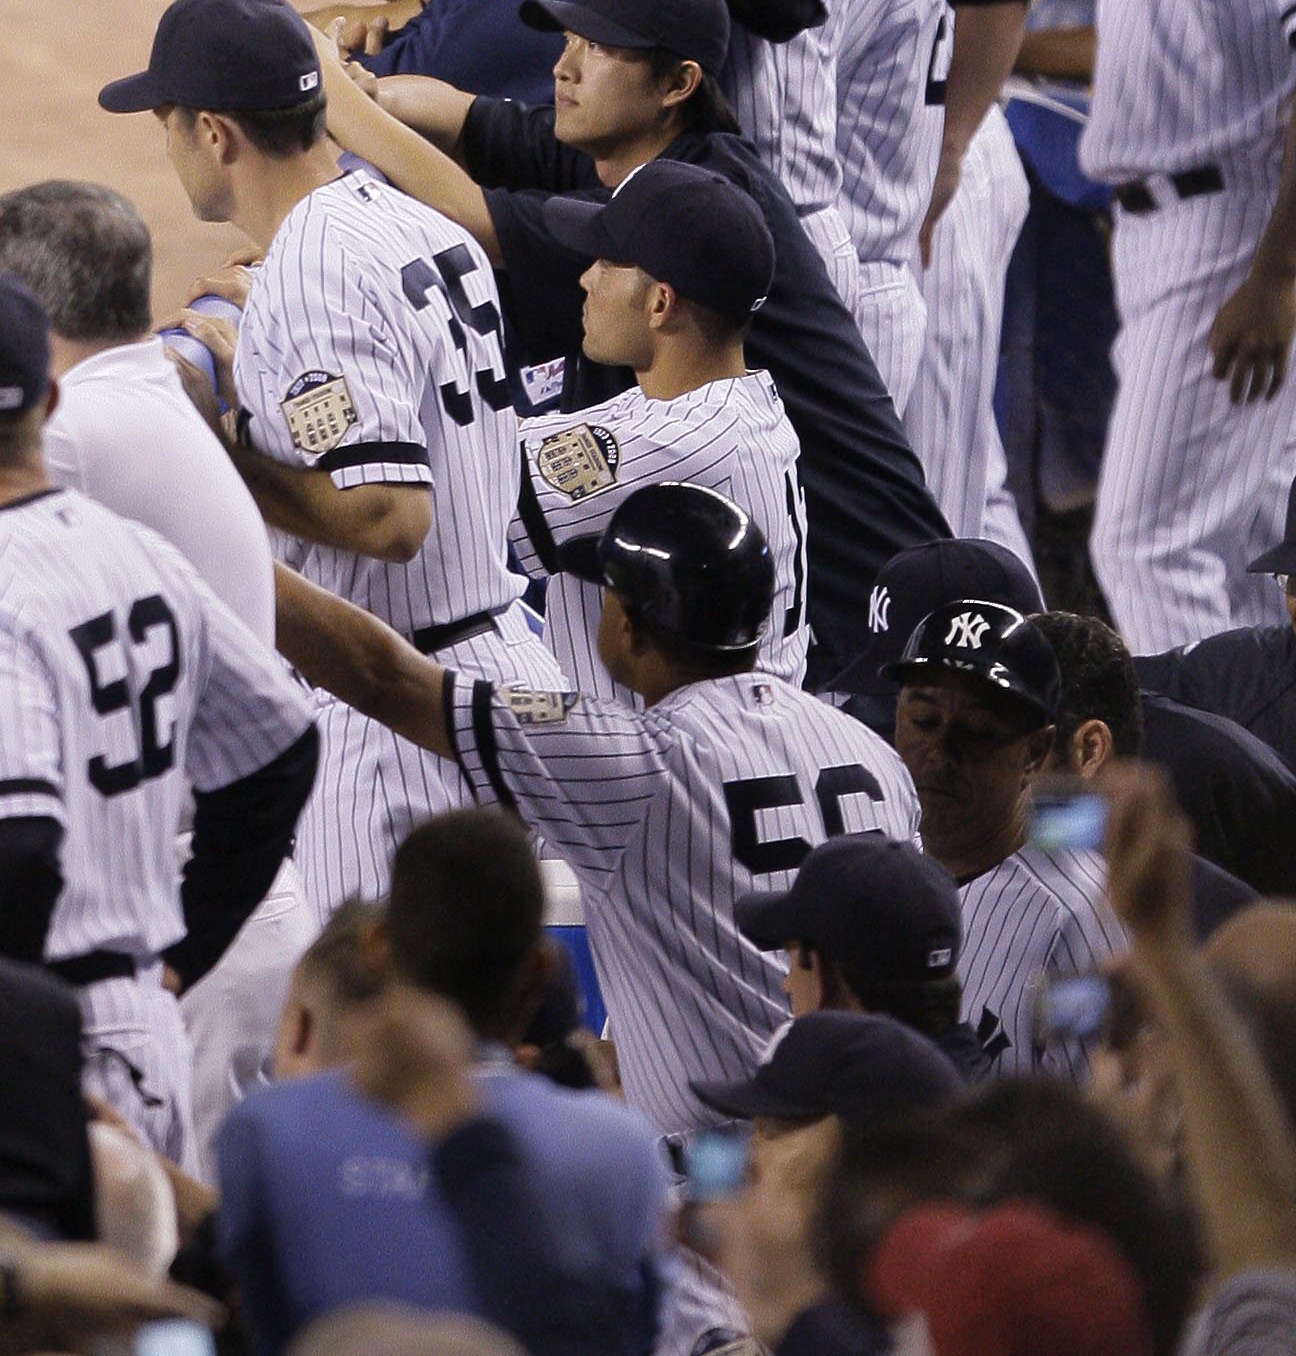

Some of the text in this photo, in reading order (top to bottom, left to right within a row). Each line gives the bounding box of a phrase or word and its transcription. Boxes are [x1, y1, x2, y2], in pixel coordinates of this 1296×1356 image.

[401, 243, 515, 427] 35
[868, 585, 892, 633] NY
[944, 611, 991, 649] NY
[68, 595, 180, 797] 52
